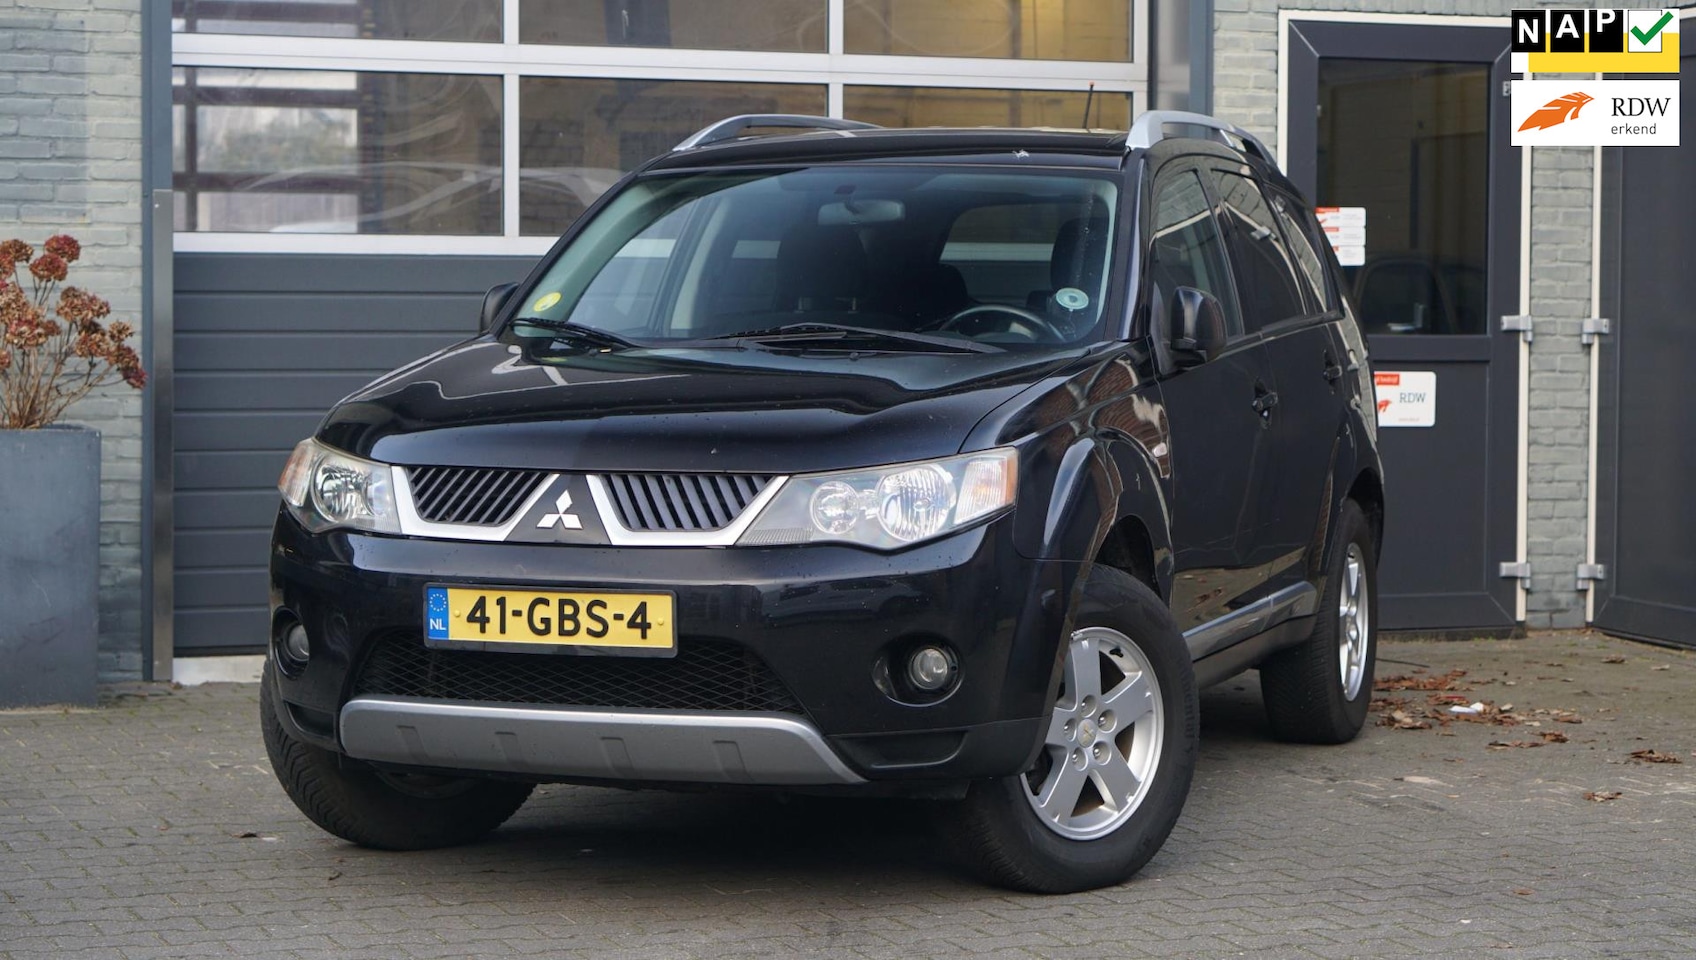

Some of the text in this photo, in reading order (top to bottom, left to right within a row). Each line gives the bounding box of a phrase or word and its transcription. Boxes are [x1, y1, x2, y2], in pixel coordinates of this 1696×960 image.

[1399, 392, 1426, 404] RDW
[466, 595, 652, 640] 41-GBS-4
[430, 618, 447, 630] NL
